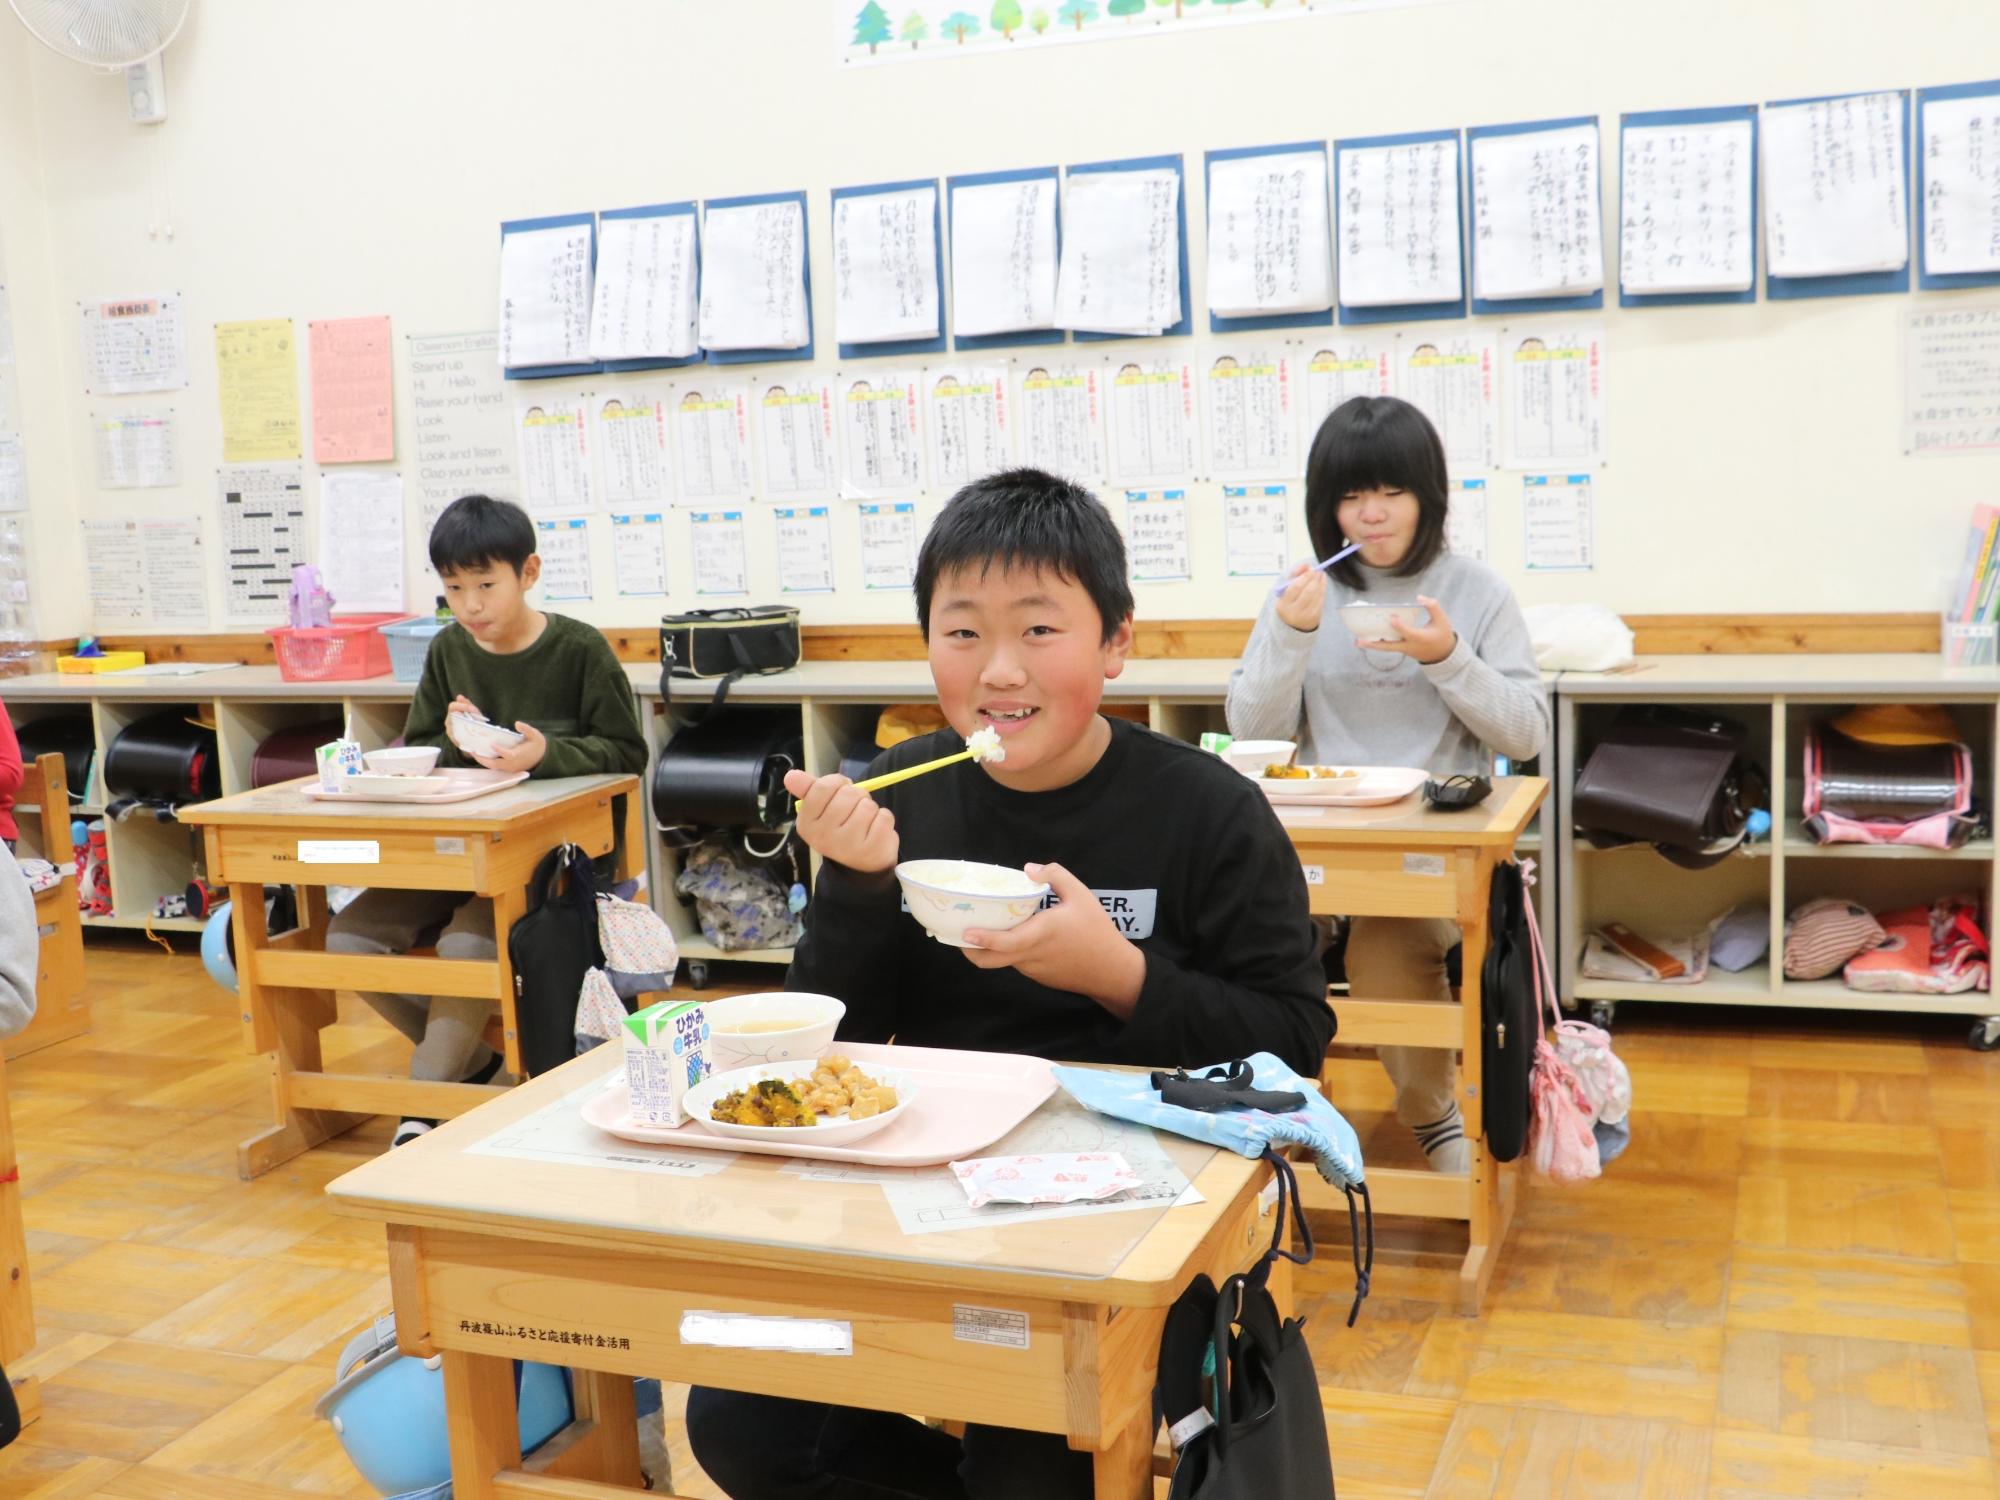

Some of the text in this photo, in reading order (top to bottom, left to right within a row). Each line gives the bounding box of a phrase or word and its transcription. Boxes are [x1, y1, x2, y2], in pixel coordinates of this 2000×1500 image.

[412, 361, 463, 373] Stand up
[414, 379, 425, 391] Hi
[449, 377, 476, 388] Hello
[416, 391, 503, 409] Raise your hand
[417, 415, 443, 426] Look
[418, 432, 450, 444] Listen
[419, 446, 502, 461] Look and listen
[421, 463, 510, 480] Clap your hands
[423, 486, 448, 498] Your
[675, 1007, 705, 1034] ひかみ
[683, 1029, 702, 1050] 牛乳
[459, 1320, 631, 1350] 丹波篠山ふるさと応援寄付金活用
